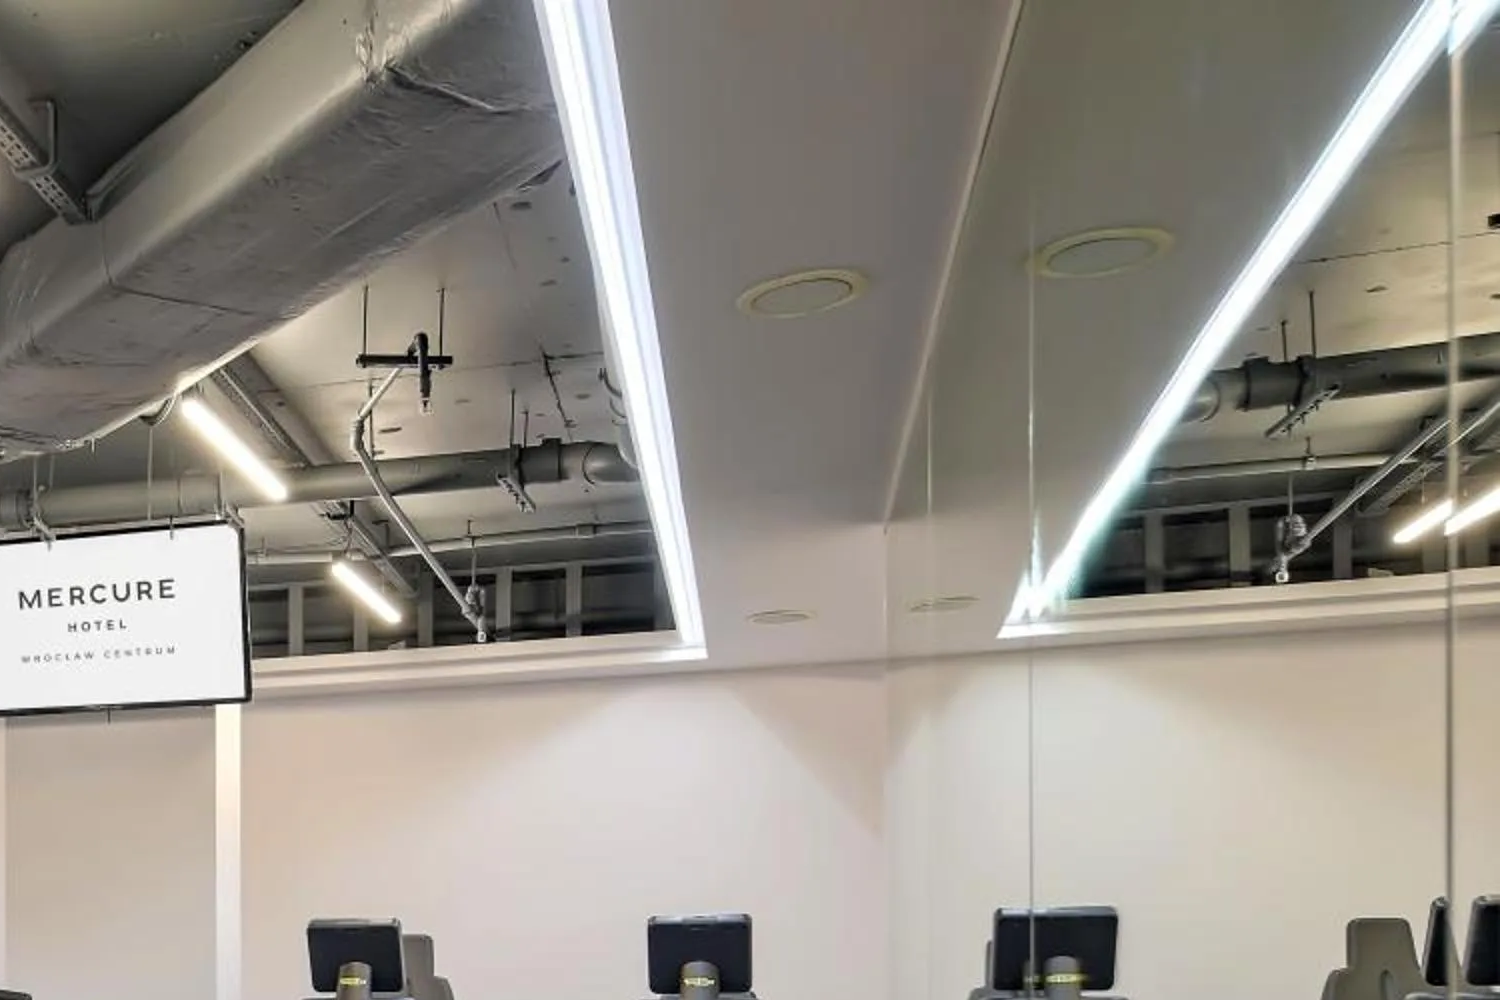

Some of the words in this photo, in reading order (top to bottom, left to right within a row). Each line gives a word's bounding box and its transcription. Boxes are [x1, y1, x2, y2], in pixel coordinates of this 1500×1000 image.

[18, 579, 176, 610] MERCURE
[67, 619, 128, 633] HOTEL
[103, 645, 177, 660] CENTRUM
